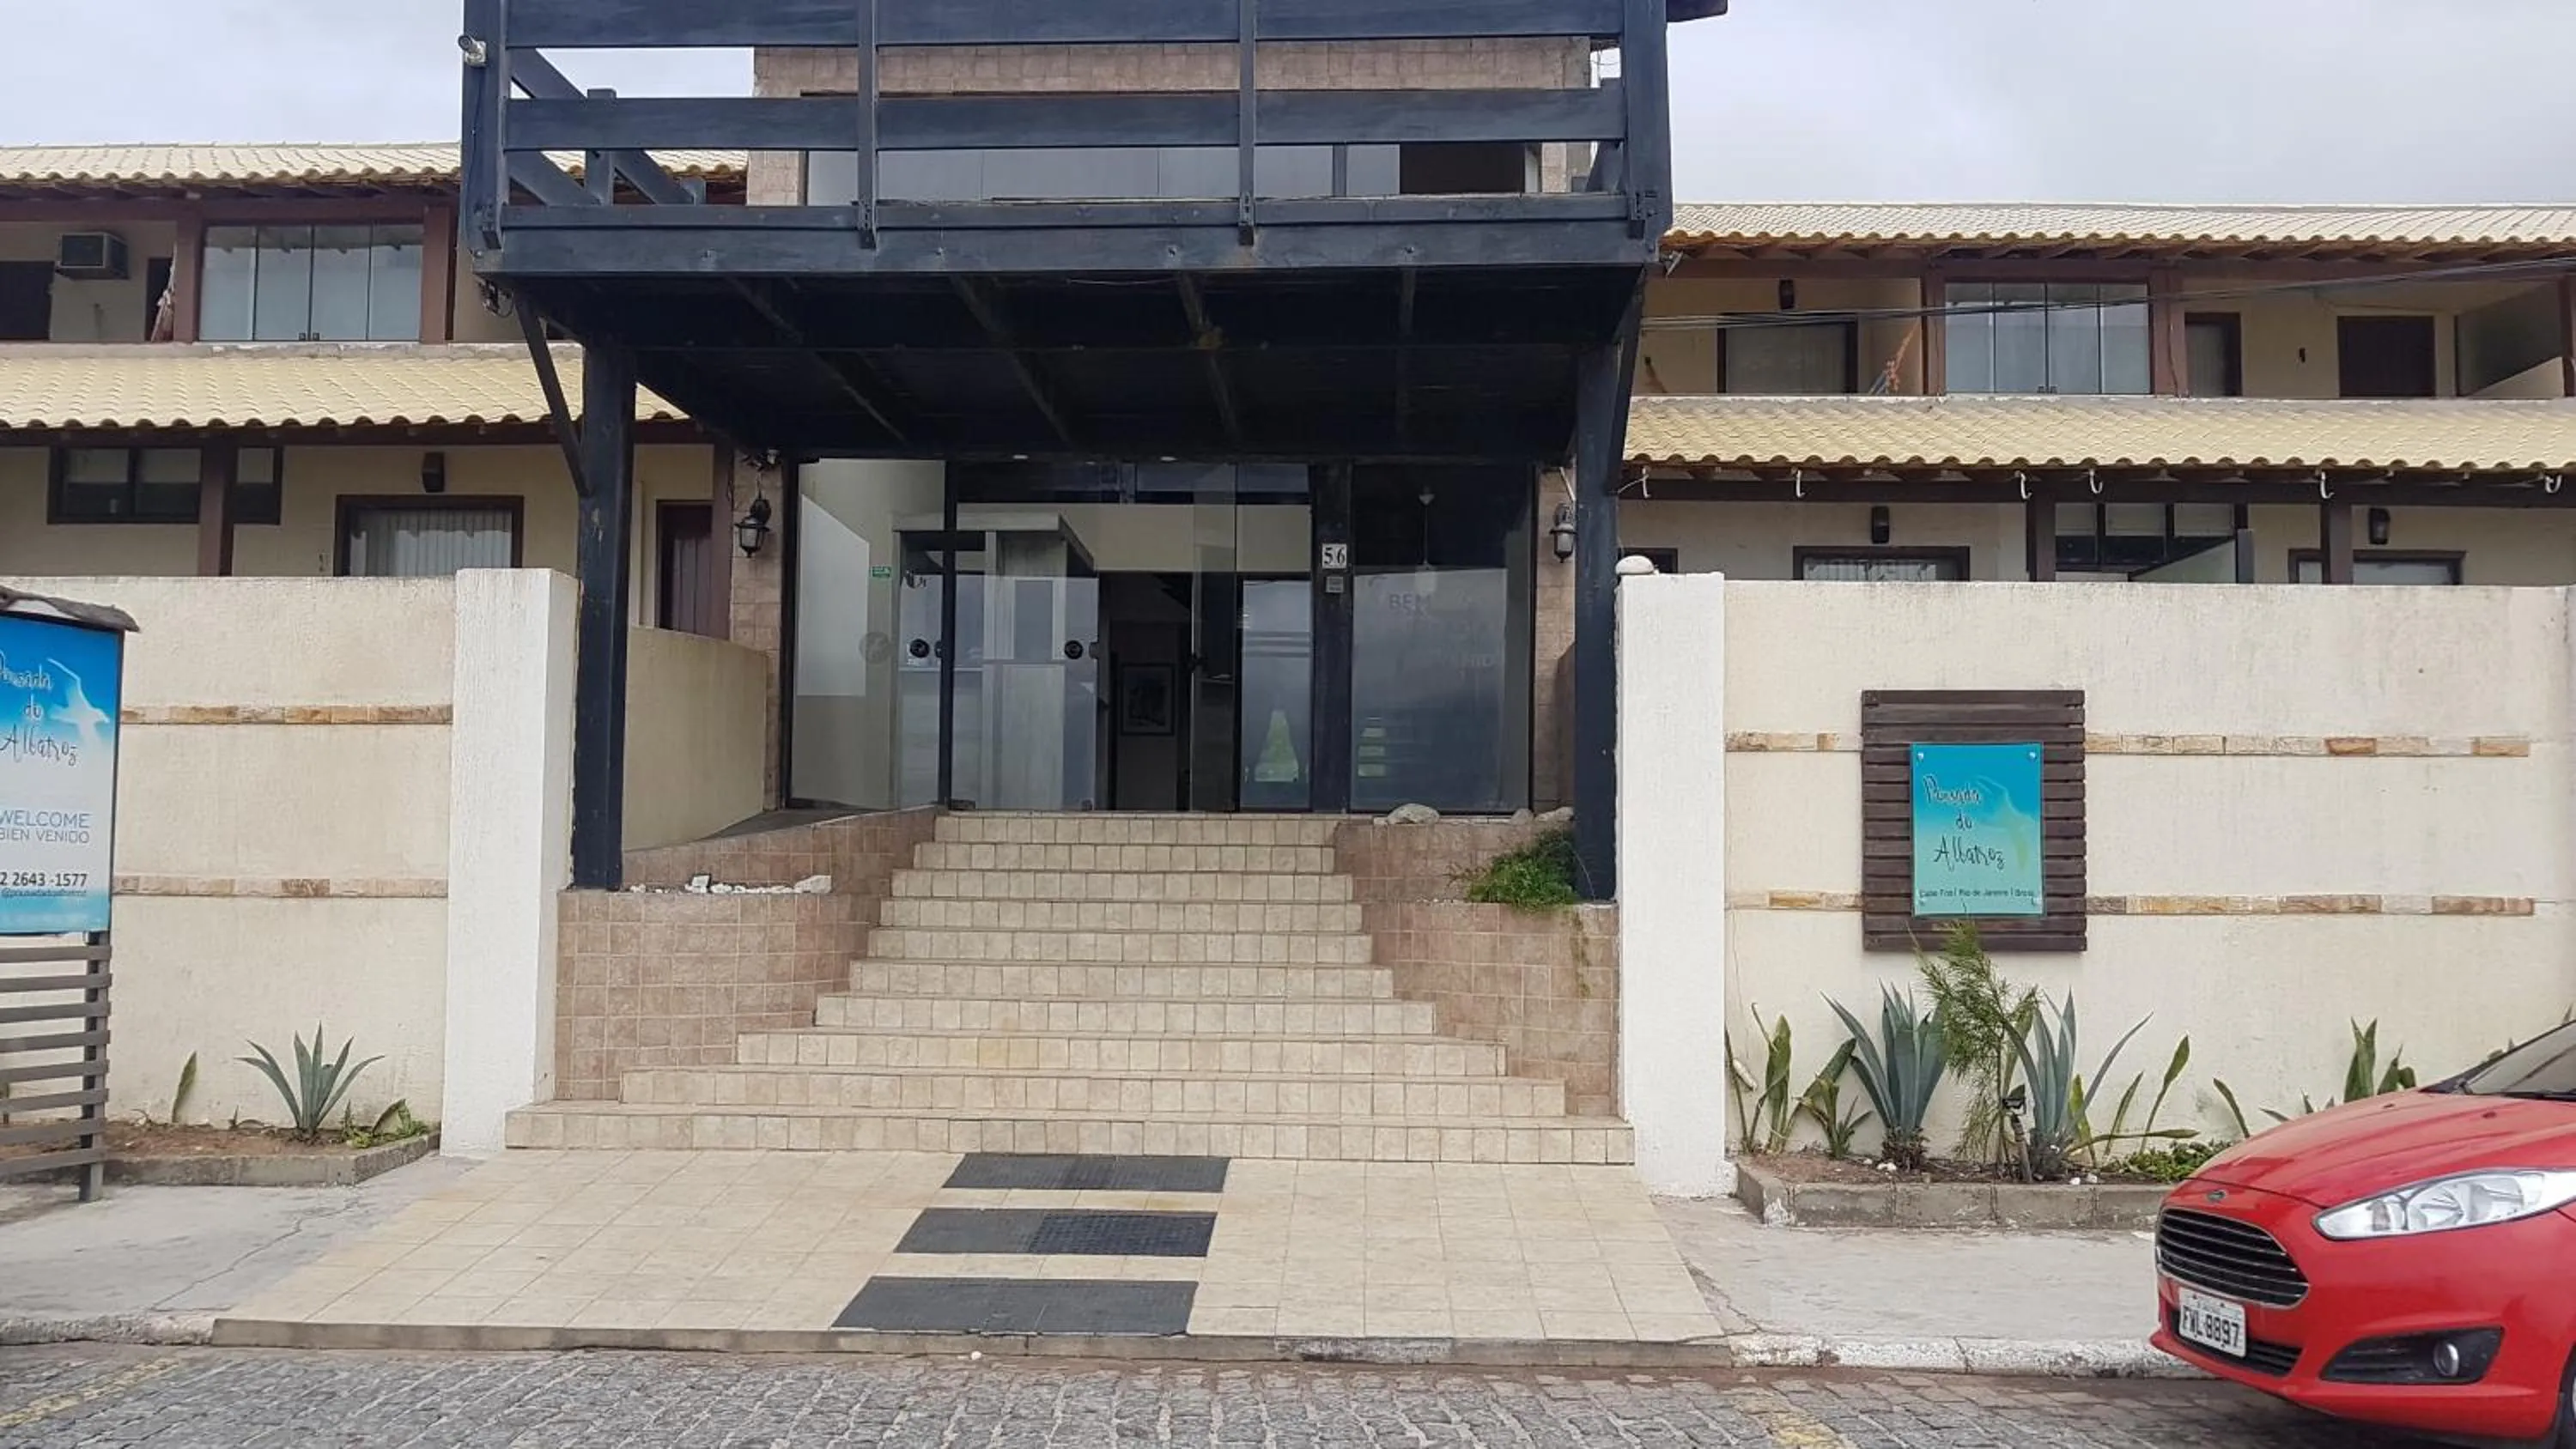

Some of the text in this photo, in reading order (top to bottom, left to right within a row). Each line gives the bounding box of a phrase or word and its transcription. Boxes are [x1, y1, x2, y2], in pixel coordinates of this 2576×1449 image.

[1323, 546, 1346, 566] 56
[0, 809, 91, 829] WELCOME
[35, 828, 90, 844] VENIDO
[12, 871, 46, 887] 2643
